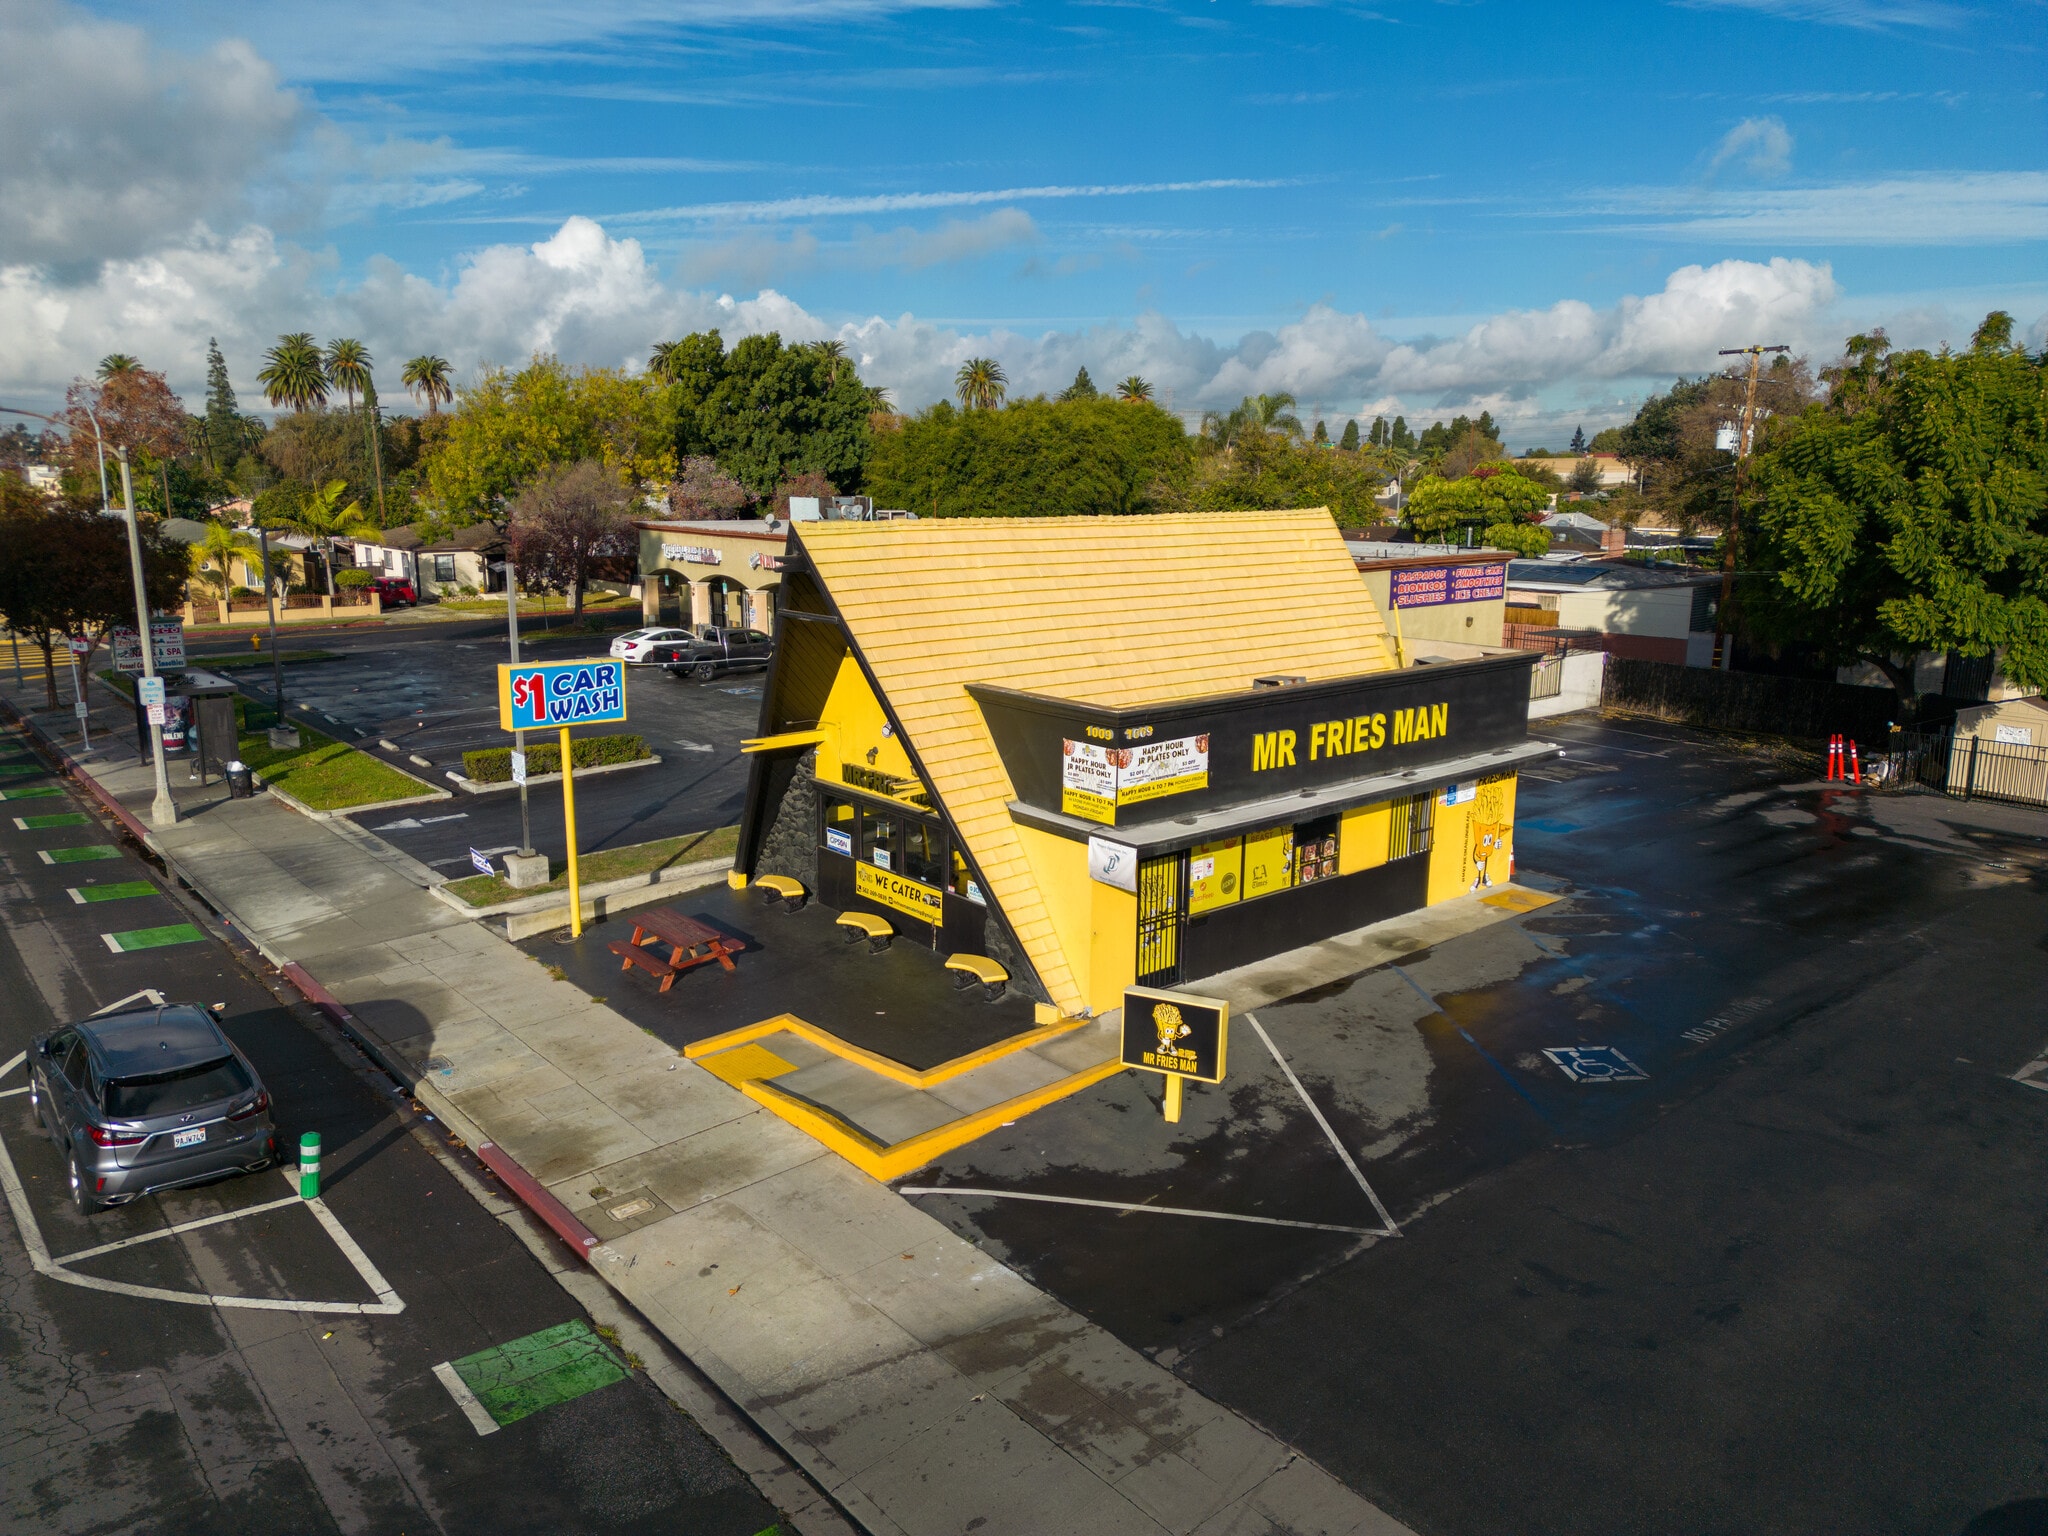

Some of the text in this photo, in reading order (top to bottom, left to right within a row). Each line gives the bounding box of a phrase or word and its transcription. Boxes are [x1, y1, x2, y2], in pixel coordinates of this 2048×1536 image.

[1398, 570, 1447, 582] RASPADOS
[1455, 565, 1504, 578] FUNNEL CAKE
[1398, 580, 1447, 594] BIONICOS
[1455, 576, 1503, 589] SMOOTHIES
[1398, 591, 1447, 606] SLUSHIES
[1455, 587, 1503, 600] ICE CREAM
[166, 647, 182, 656] SPA
[513, 665, 615, 721] $1 CAR
[549, 687, 619, 722] WASH
[1085, 725, 1114, 740] 1009
[1124, 725, 1154, 740] 1009
[1252, 702, 1449, 772] MR FRIES MAN
[1142, 741, 1184, 756] HAPPY HOUR
[1070, 756, 1107, 770] HAPPY HOUR
[1138, 748, 1190, 767] JR PLATES ONLY
[1067, 762, 1074, 770] JR
[1074, 764, 1095, 776] PLATES
[1095, 769, 1112, 779] ONLY
[1079, 793, 1092, 801] HOUR
[1122, 789, 1137, 797] HAPPY
[1252, 864, 1268, 880] LA
[875, 873, 889, 890] WE
[891, 881, 921, 902] CATER
[1252, 879, 1268, 889] Times
[1680, 1027, 1716, 1044] NO
[1143, 1051, 1155, 1065] MR
[1156, 1054, 1178, 1070] FRIES
[1179, 1058, 1198, 1073] MAN
